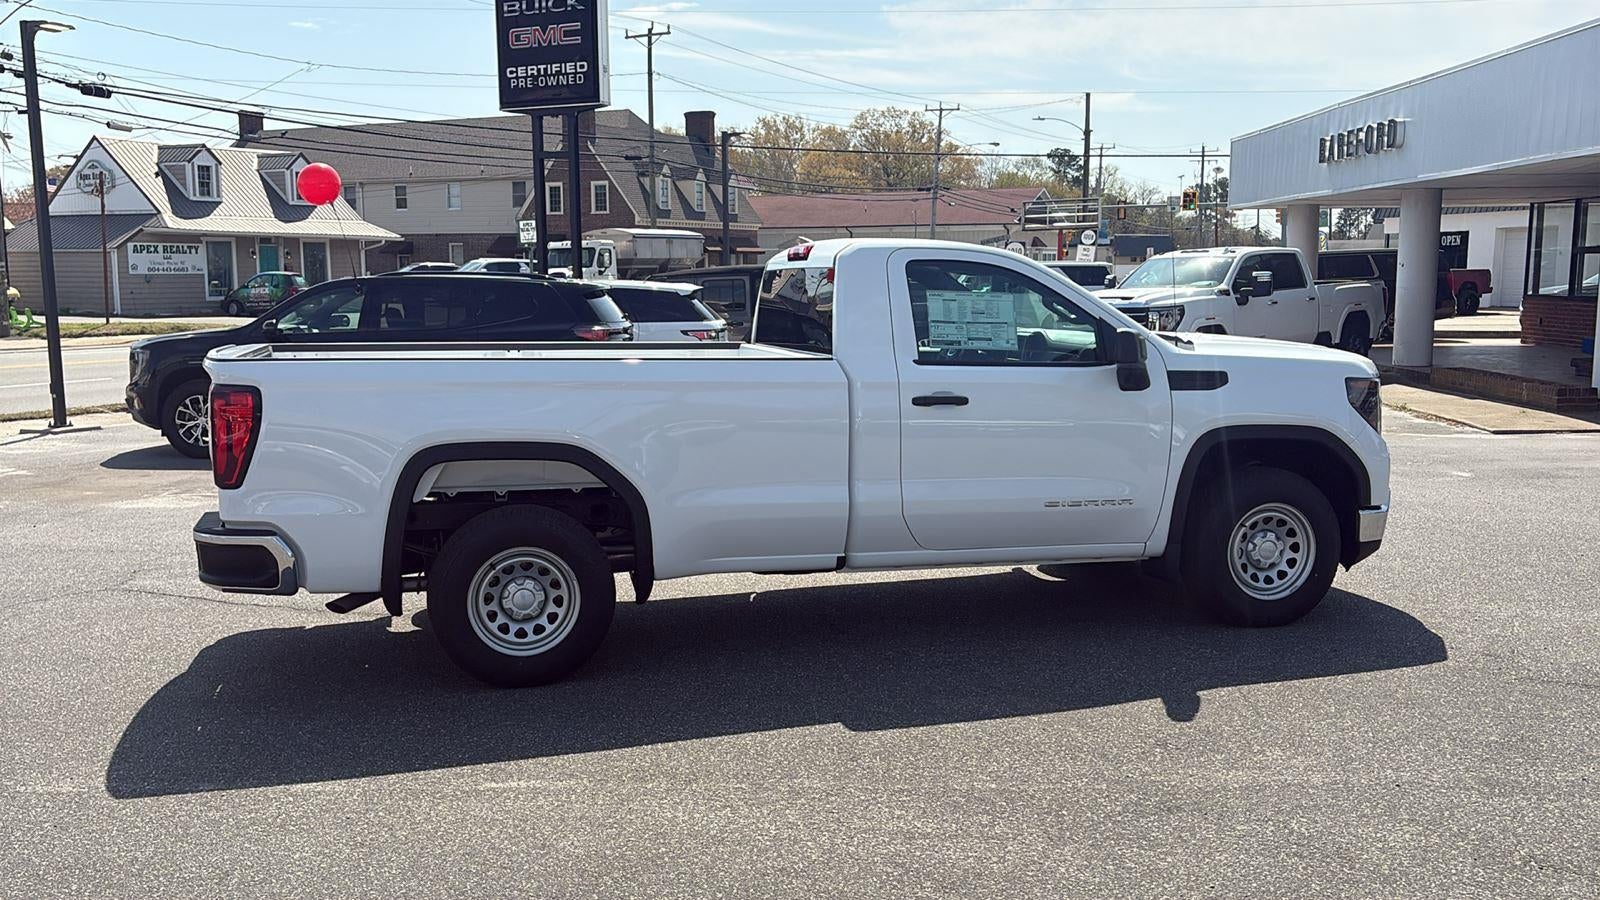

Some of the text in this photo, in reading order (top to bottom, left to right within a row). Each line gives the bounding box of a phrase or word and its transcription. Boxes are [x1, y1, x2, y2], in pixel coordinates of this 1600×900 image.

[503, 0, 585, 17] BUICK
[509, 22, 582, 49] GMC
[506, 61, 588, 78] CERTIFIED
[510, 74, 585, 89] PRE-OWNED
[1318, 118, 1400, 164] BAREFORD
[1441, 235, 1462, 246] OPEN
[132, 244, 200, 255] APEX REALTY
[1043, 497, 1135, 509] SIERRA
